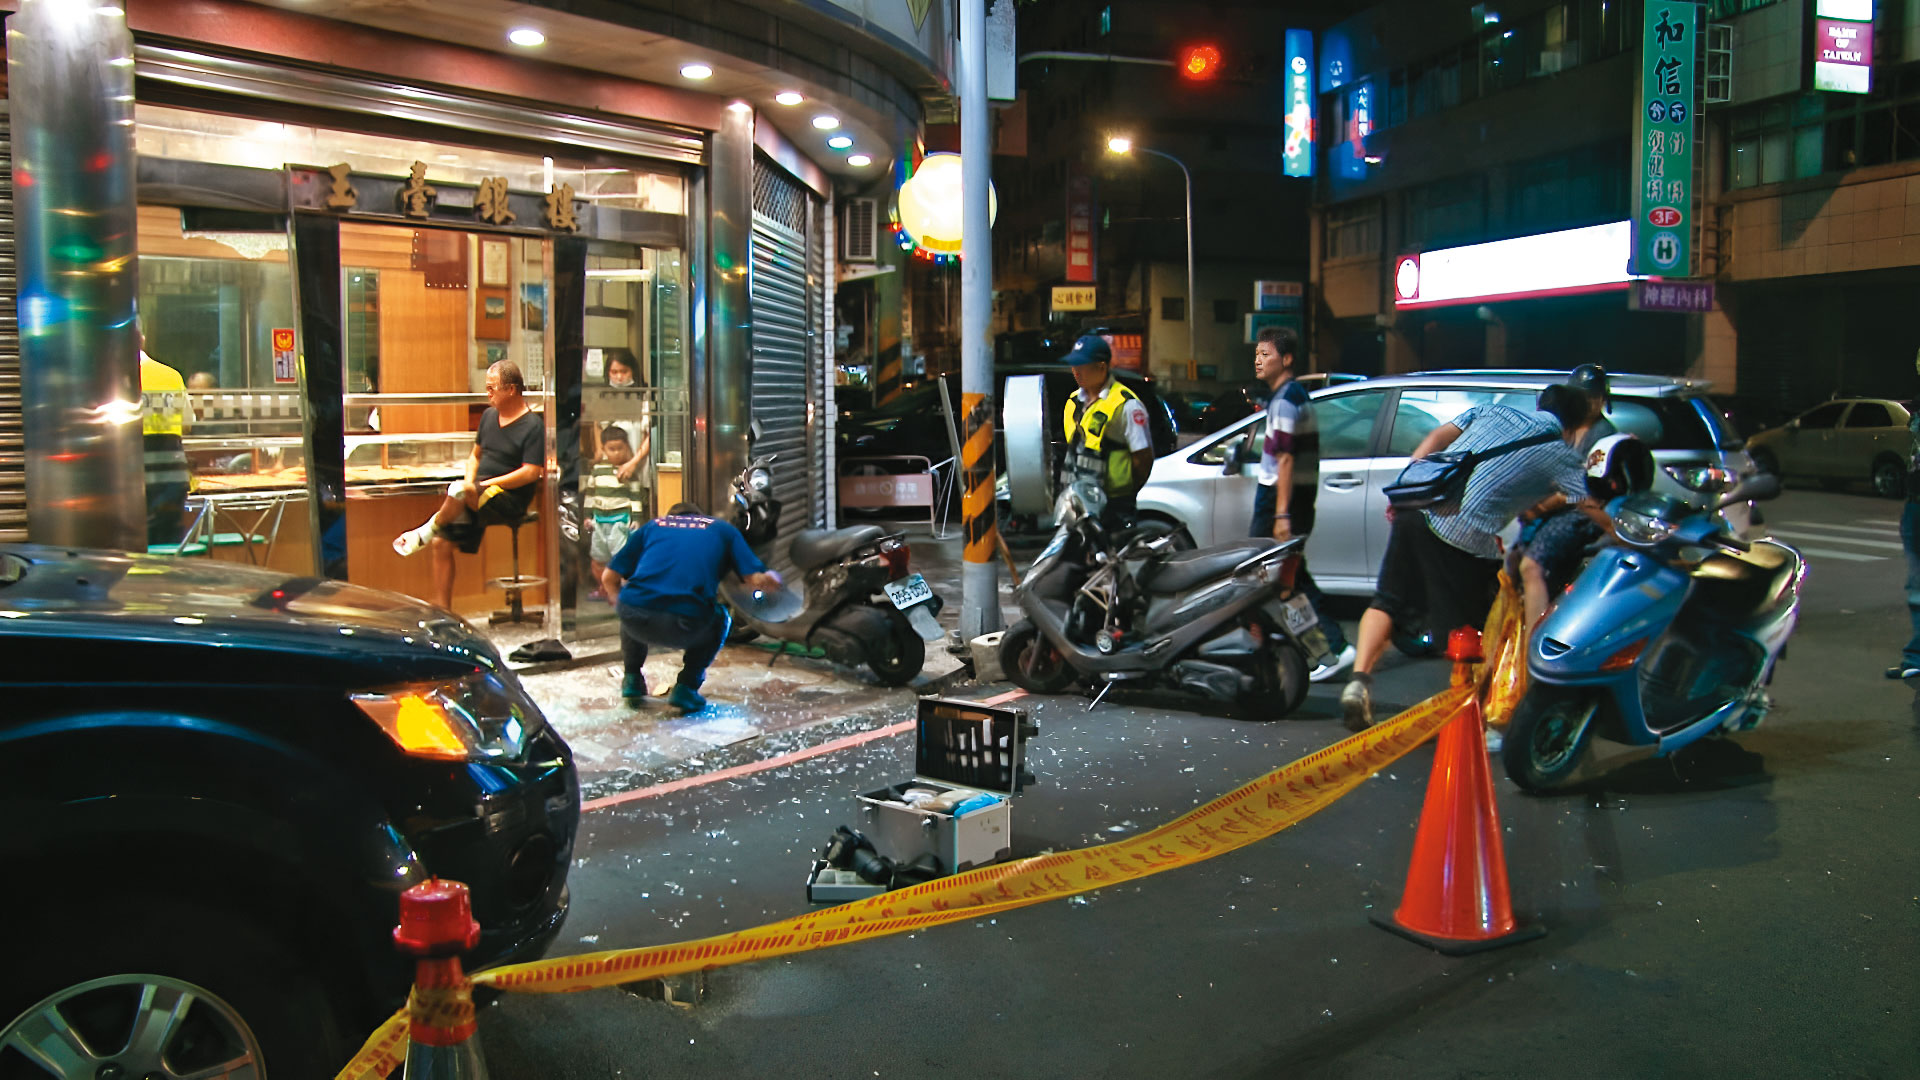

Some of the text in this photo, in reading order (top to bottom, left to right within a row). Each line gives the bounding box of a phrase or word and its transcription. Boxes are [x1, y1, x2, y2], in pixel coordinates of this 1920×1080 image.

[1654, 9, 1685, 96] 和信
[1823, 49, 1862, 62] TAIWAN
[327, 160, 578, 233] 玉臺銀樓
[1655, 210, 1674, 225] 3F
[1644, 286, 1708, 308] 神經內科
